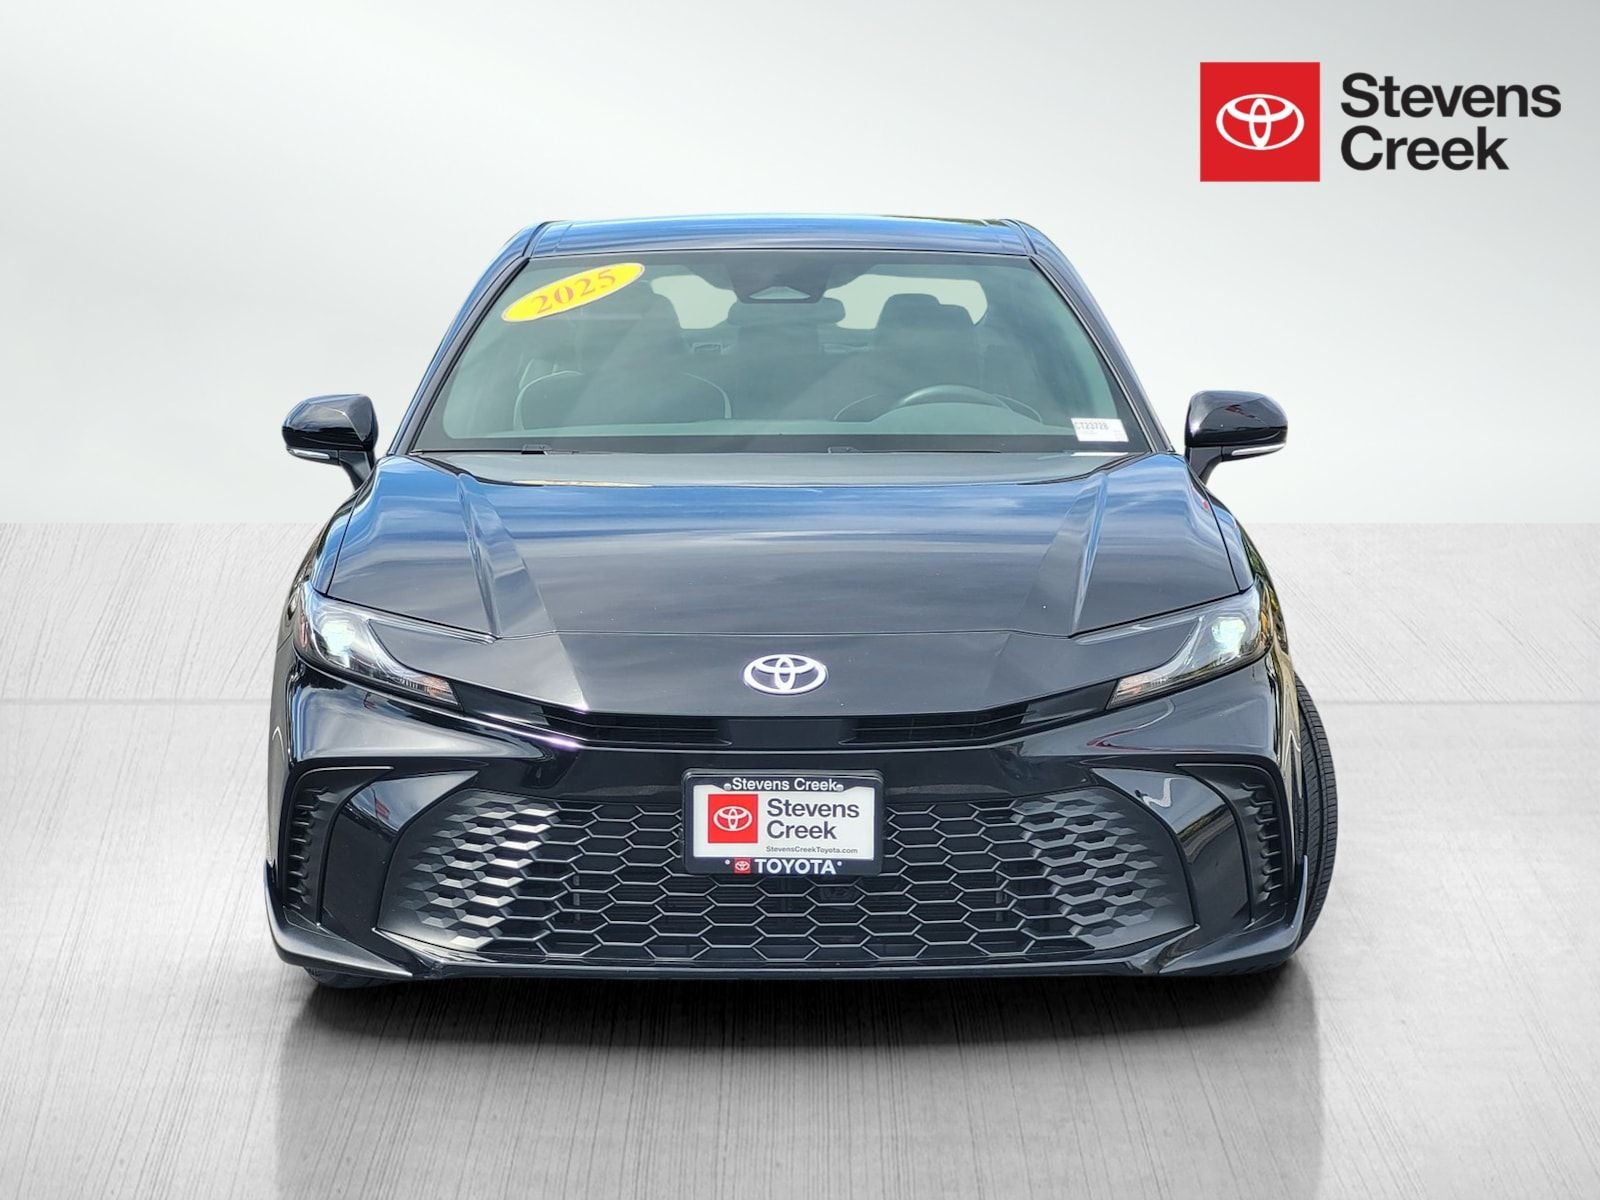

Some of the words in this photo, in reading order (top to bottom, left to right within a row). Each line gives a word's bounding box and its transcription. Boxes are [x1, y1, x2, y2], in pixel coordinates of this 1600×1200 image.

[532, 268, 616, 314] 2025
[732, 777, 790, 791] Stevens
[794, 778, 837, 792] Creek
[767, 798, 860, 818] Stevens
[766, 820, 837, 840] Creek
[766, 845, 858, 854] StevensCreekToyota.com
[755, 859, 837, 875] TOYOTA
